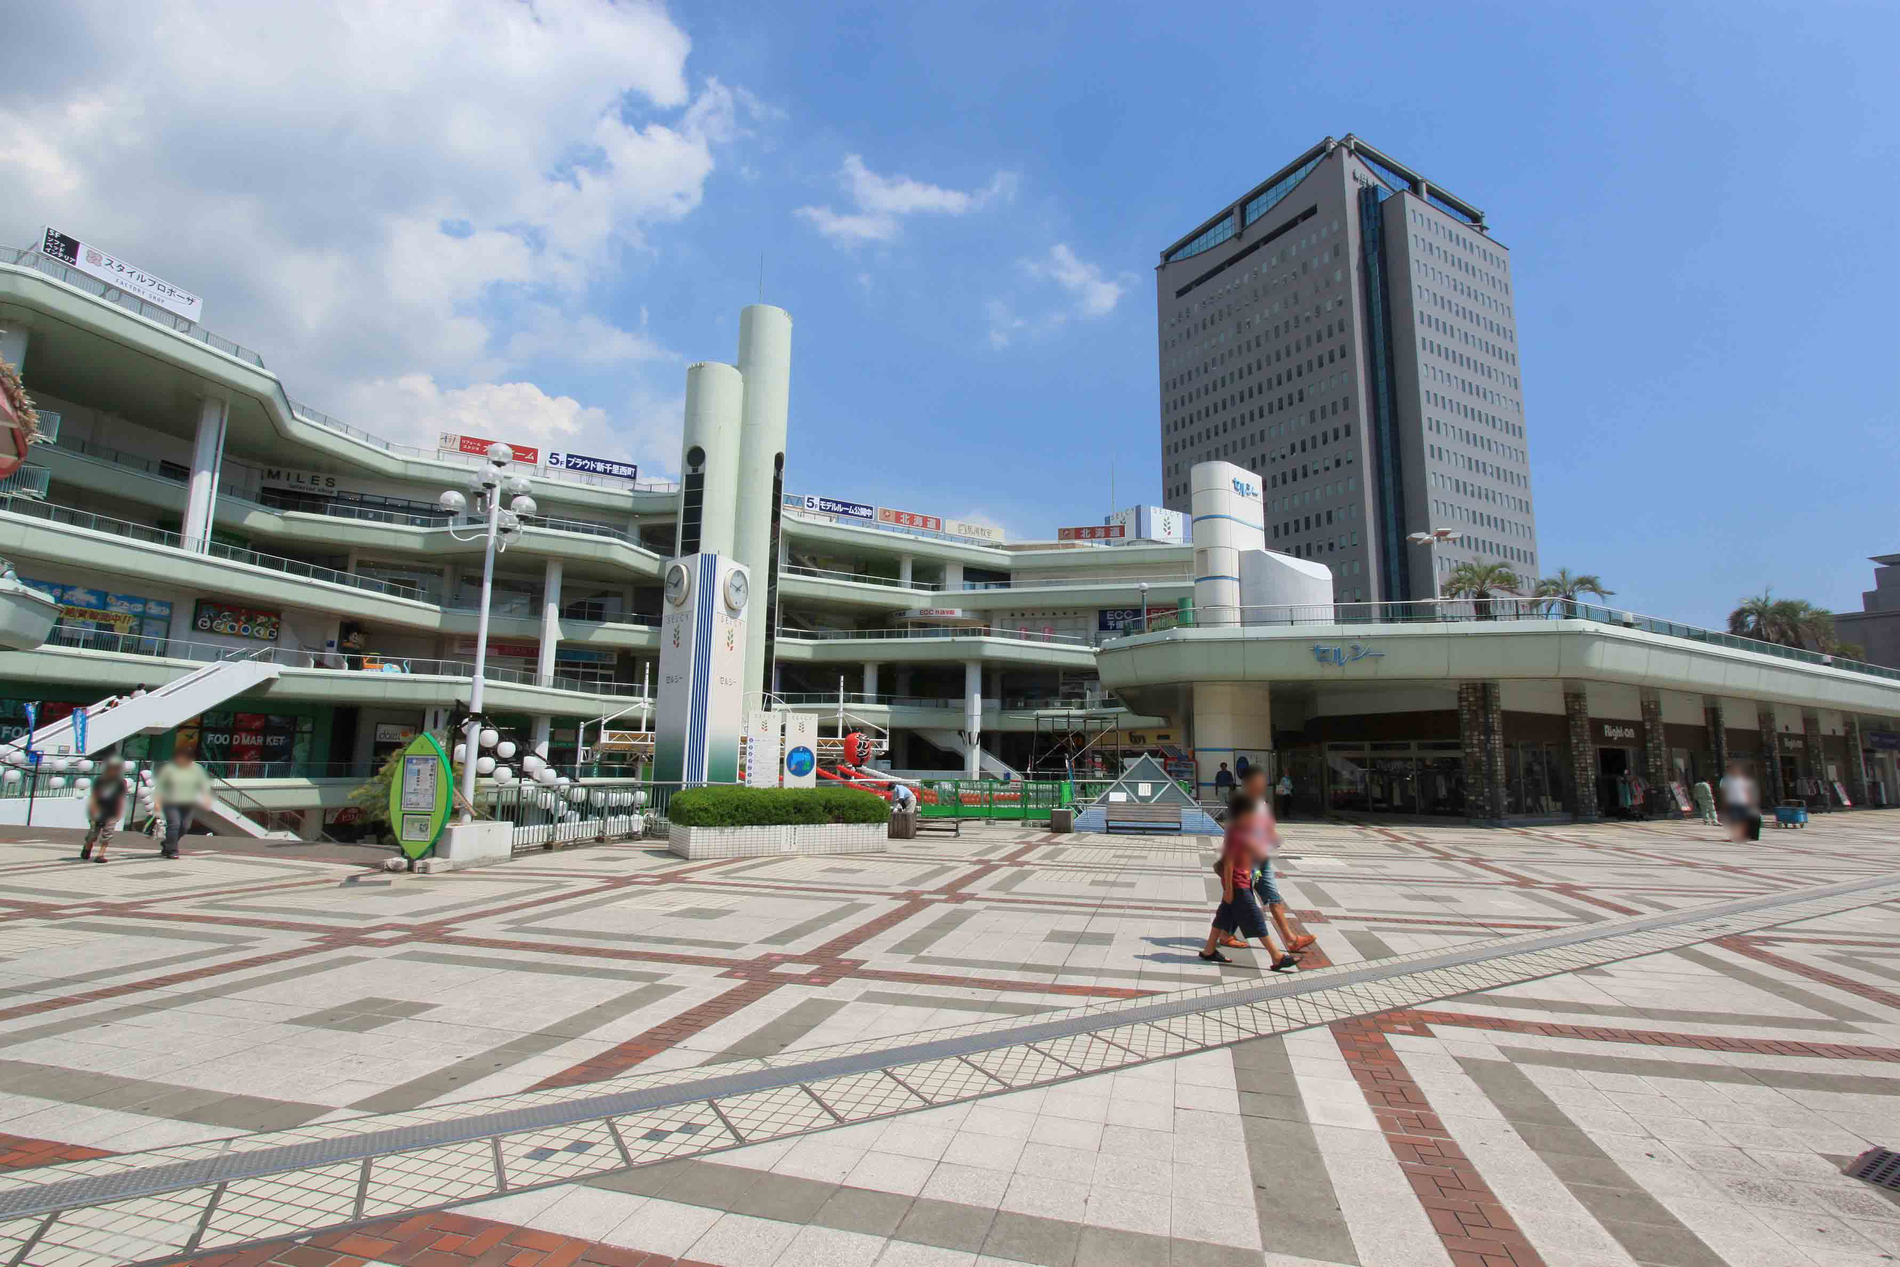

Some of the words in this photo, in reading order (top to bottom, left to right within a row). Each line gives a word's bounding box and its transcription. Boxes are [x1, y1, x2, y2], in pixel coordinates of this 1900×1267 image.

[567, 457, 636, 477] プラウド新千里西町
[267, 469, 336, 488] MILES
[820, 500, 873, 517] モデルルーム公開中
[900, 513, 938, 528] 北海道
[1080, 525, 1121, 539] 北海道
[1106, 610, 1133, 620] ECC
[1309, 642, 1386, 667] セルシー
[1604, 724, 1635, 740] Right-on
